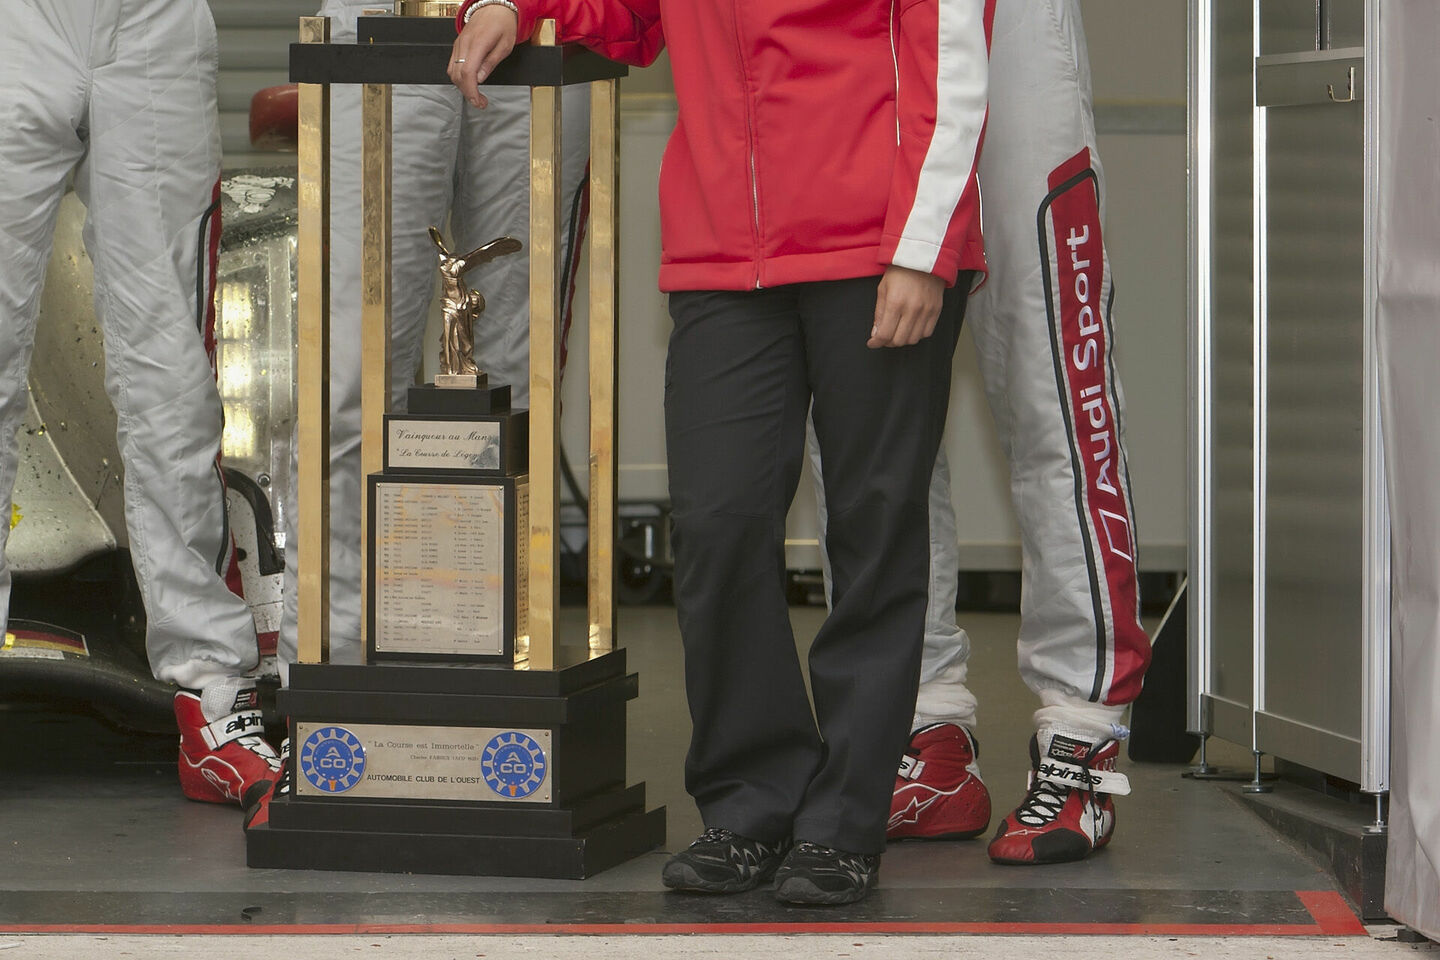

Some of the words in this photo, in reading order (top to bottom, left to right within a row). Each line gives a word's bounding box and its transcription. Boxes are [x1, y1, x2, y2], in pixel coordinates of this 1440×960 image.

[1066, 224, 1104, 372] Sport
[396, 428, 445, 442] Vainqueur
[464, 431, 490, 441] Man
[1079, 383, 1119, 498] Audi
[387, 741, 413, 749] Course
[367, 774, 412, 782] AUTOMOBILE
[416, 775, 435, 783] CLUB
[451, 776, 480, 784] L'OUEST
